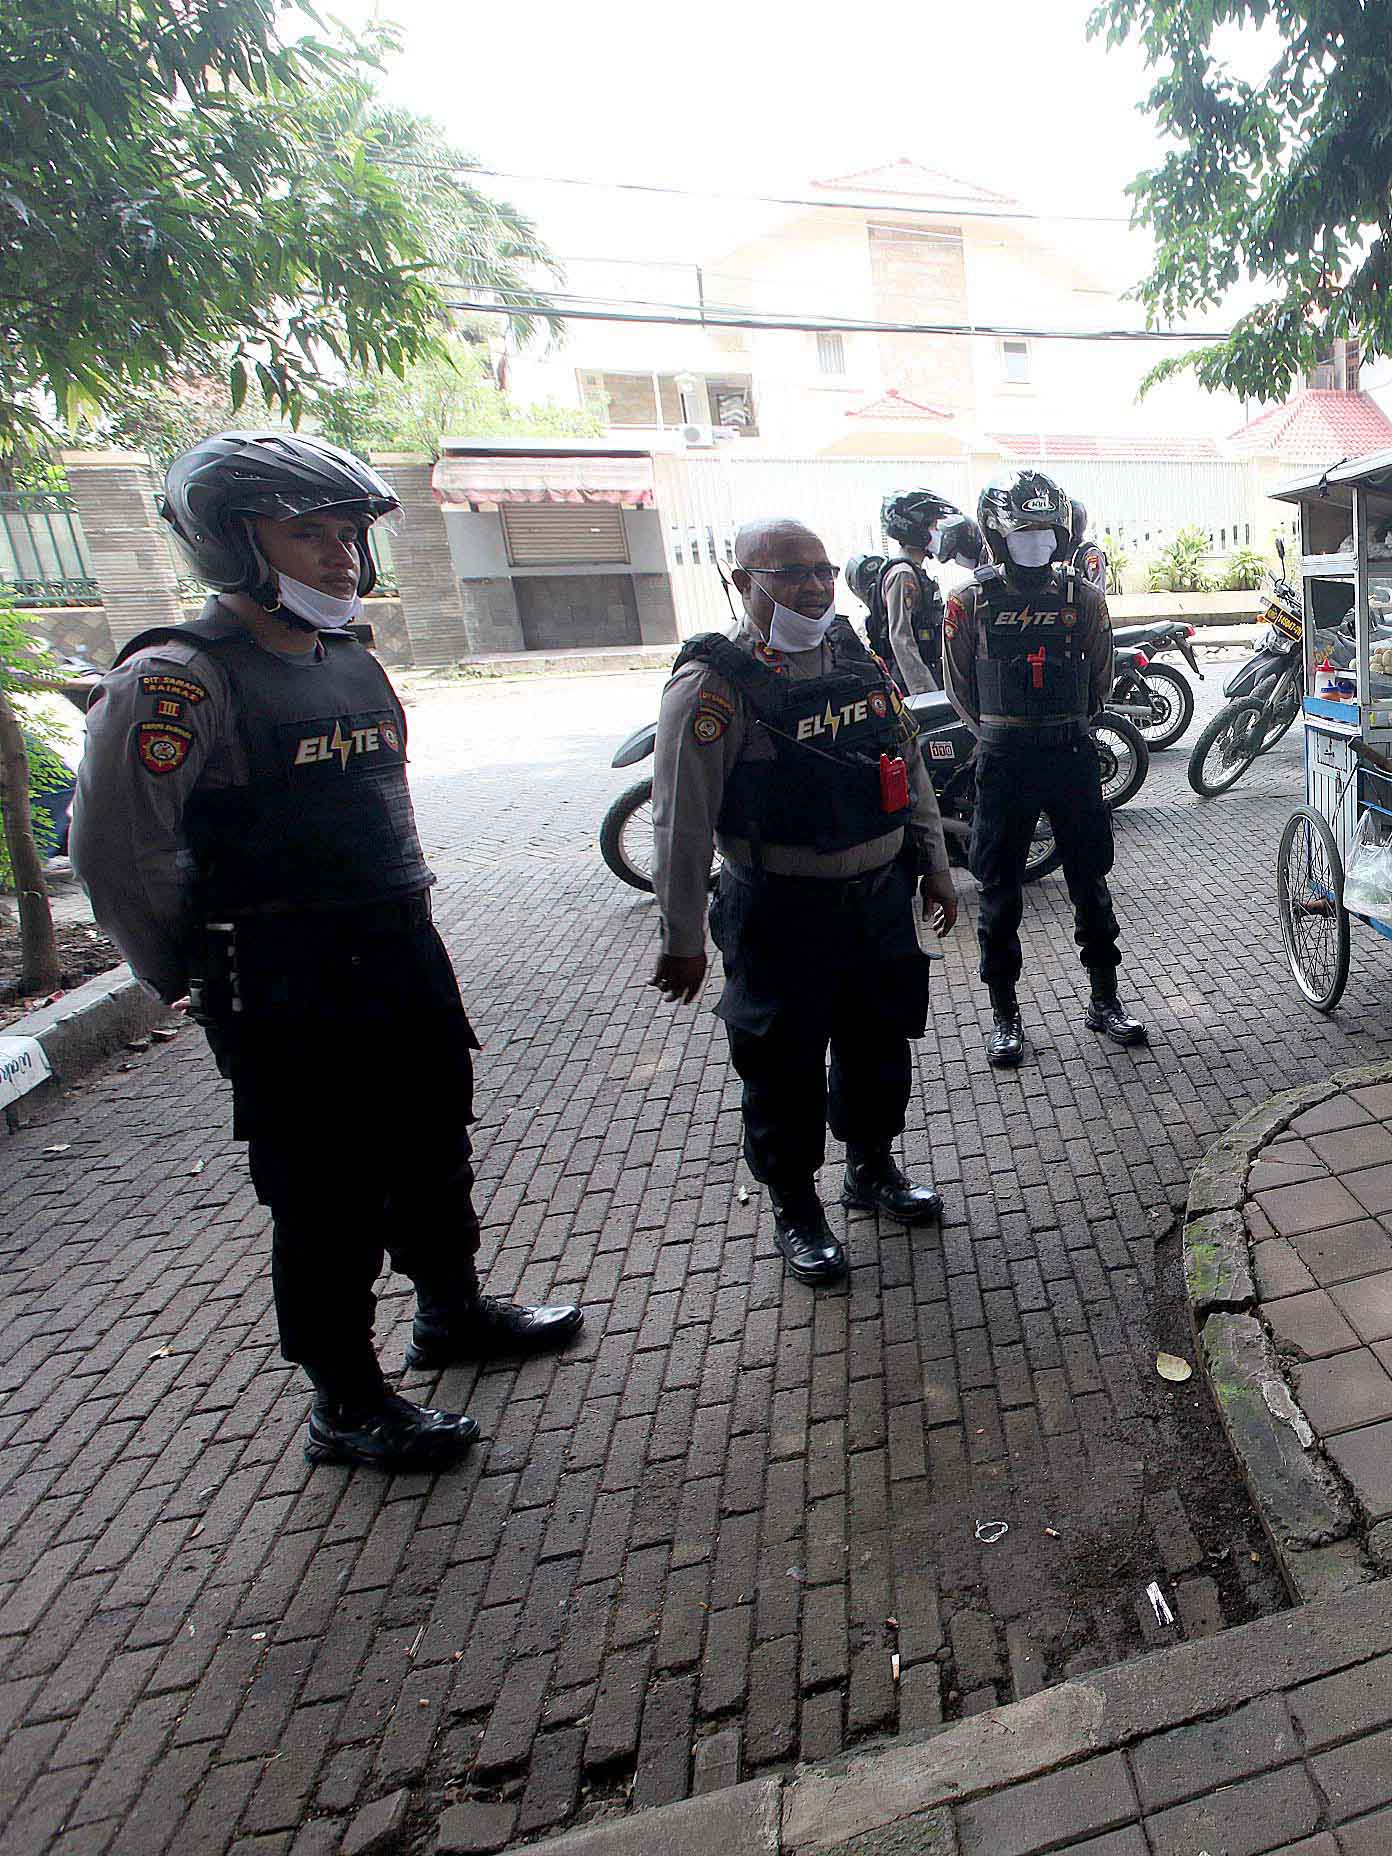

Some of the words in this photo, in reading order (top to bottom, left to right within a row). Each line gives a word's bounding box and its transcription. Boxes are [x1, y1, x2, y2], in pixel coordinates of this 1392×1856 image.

[995, 604, 1059, 632] ELITE
[797, 699, 867, 742] ELITE
[294, 720, 380, 771] ELITE
